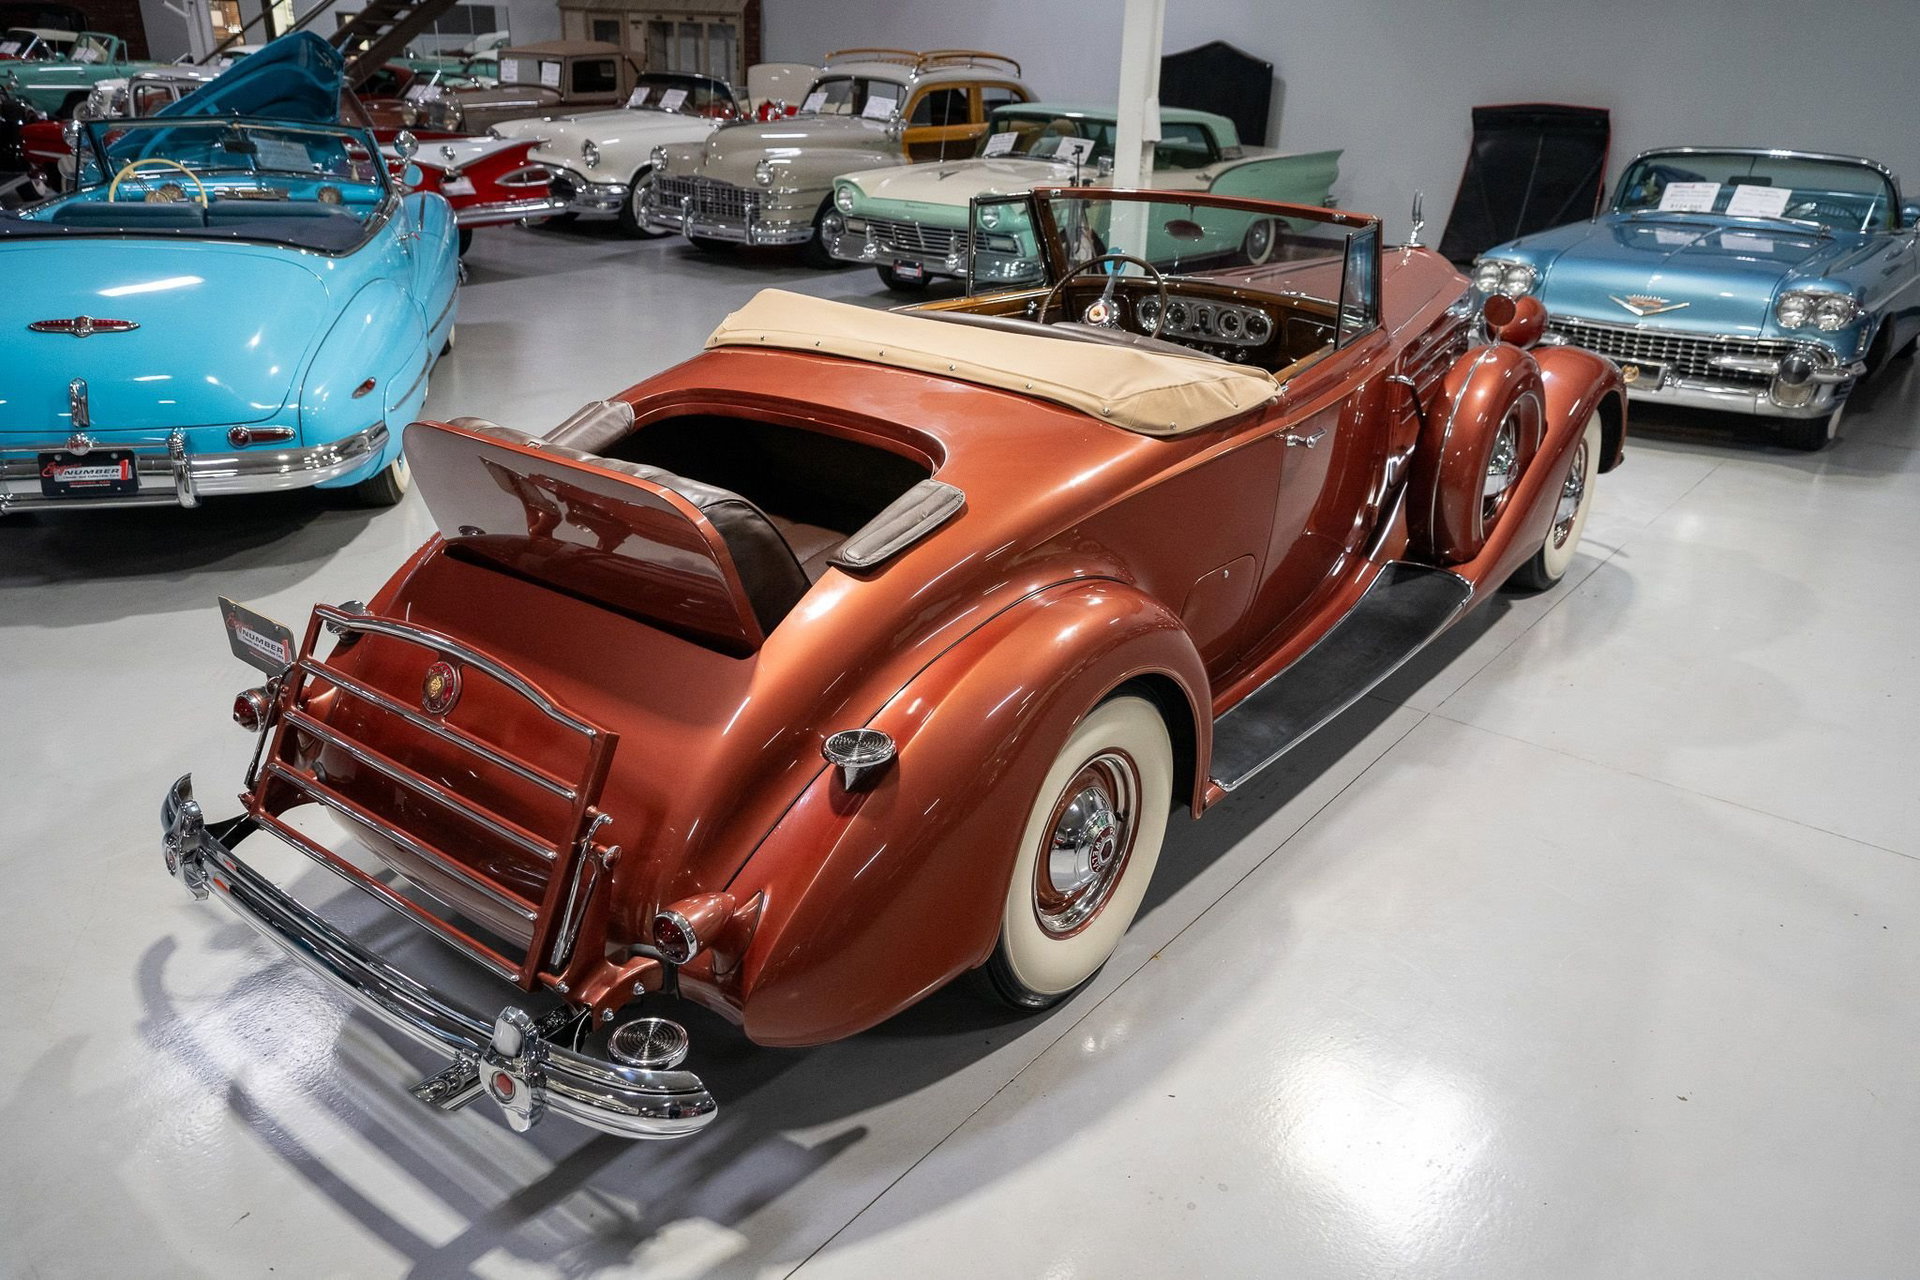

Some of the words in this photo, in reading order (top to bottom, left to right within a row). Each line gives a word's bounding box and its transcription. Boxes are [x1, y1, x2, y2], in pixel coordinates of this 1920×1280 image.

[64, 468, 119, 476] NUMBER
[120, 459, 129, 480] 1
[242, 629, 283, 655] NUMBER
